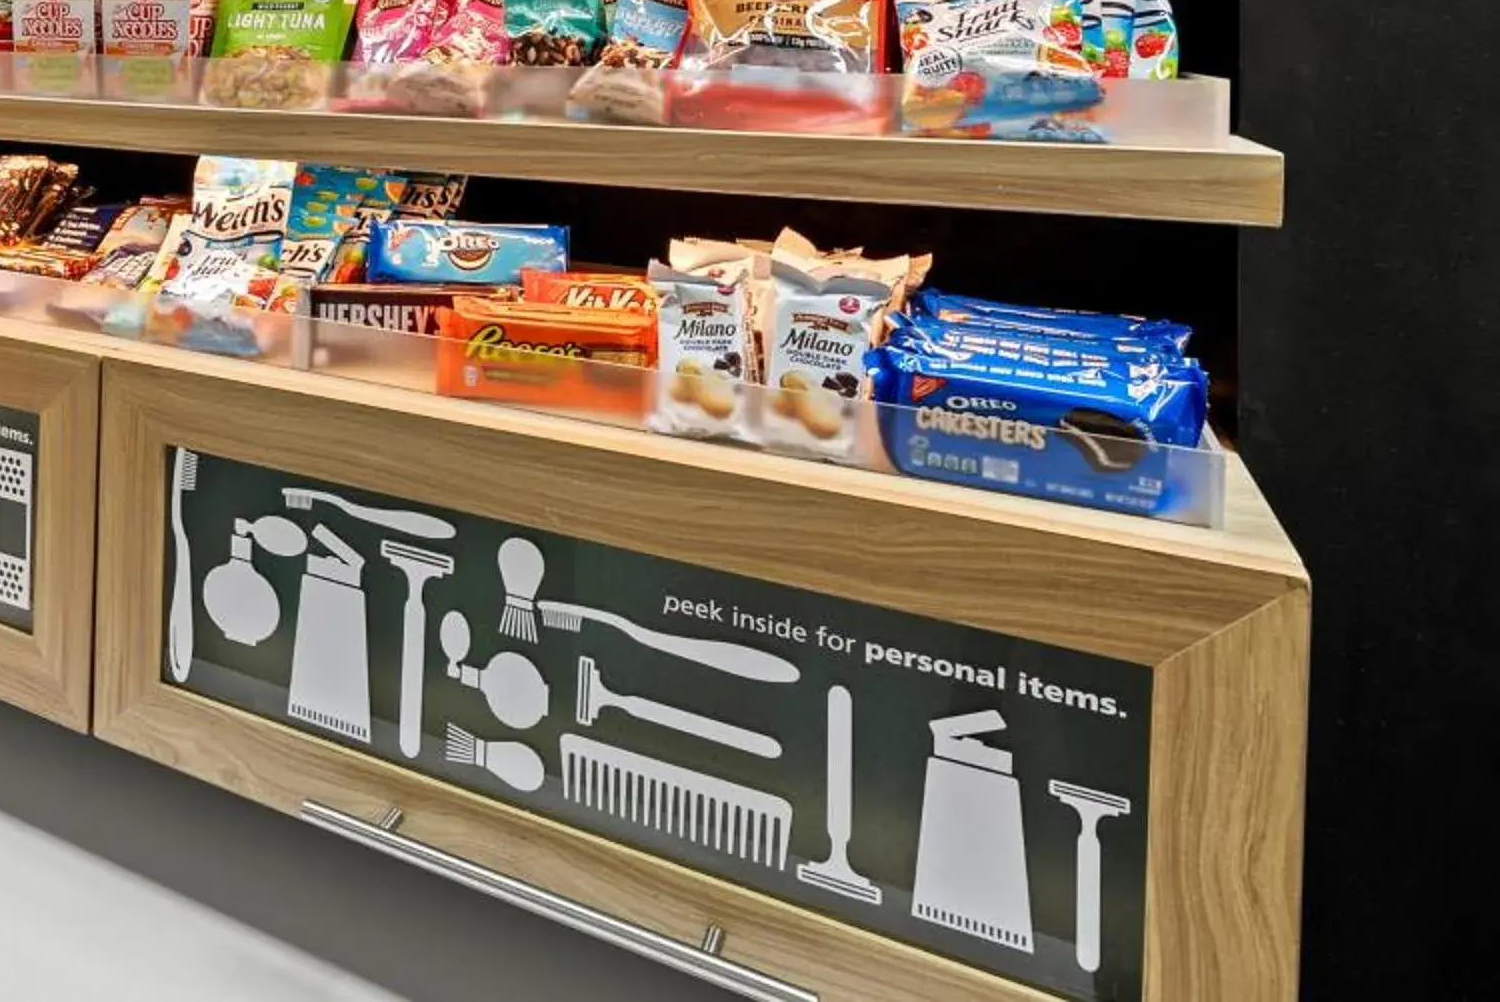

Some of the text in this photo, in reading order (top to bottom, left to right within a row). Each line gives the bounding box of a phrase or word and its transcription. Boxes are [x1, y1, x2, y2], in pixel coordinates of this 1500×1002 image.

[36, 1, 70, 20] CUP
[126, 2, 165, 20] CUP
[227, 12, 326, 30] LIGHT TUNA
[674, 318, 737, 339] Milano
[780, 327, 854, 357] Milano
[945, 394, 1017, 411] OREO
[915, 405, 1047, 450] CAKESTERS
[663, 595, 1128, 719] peek inside for personal items.
